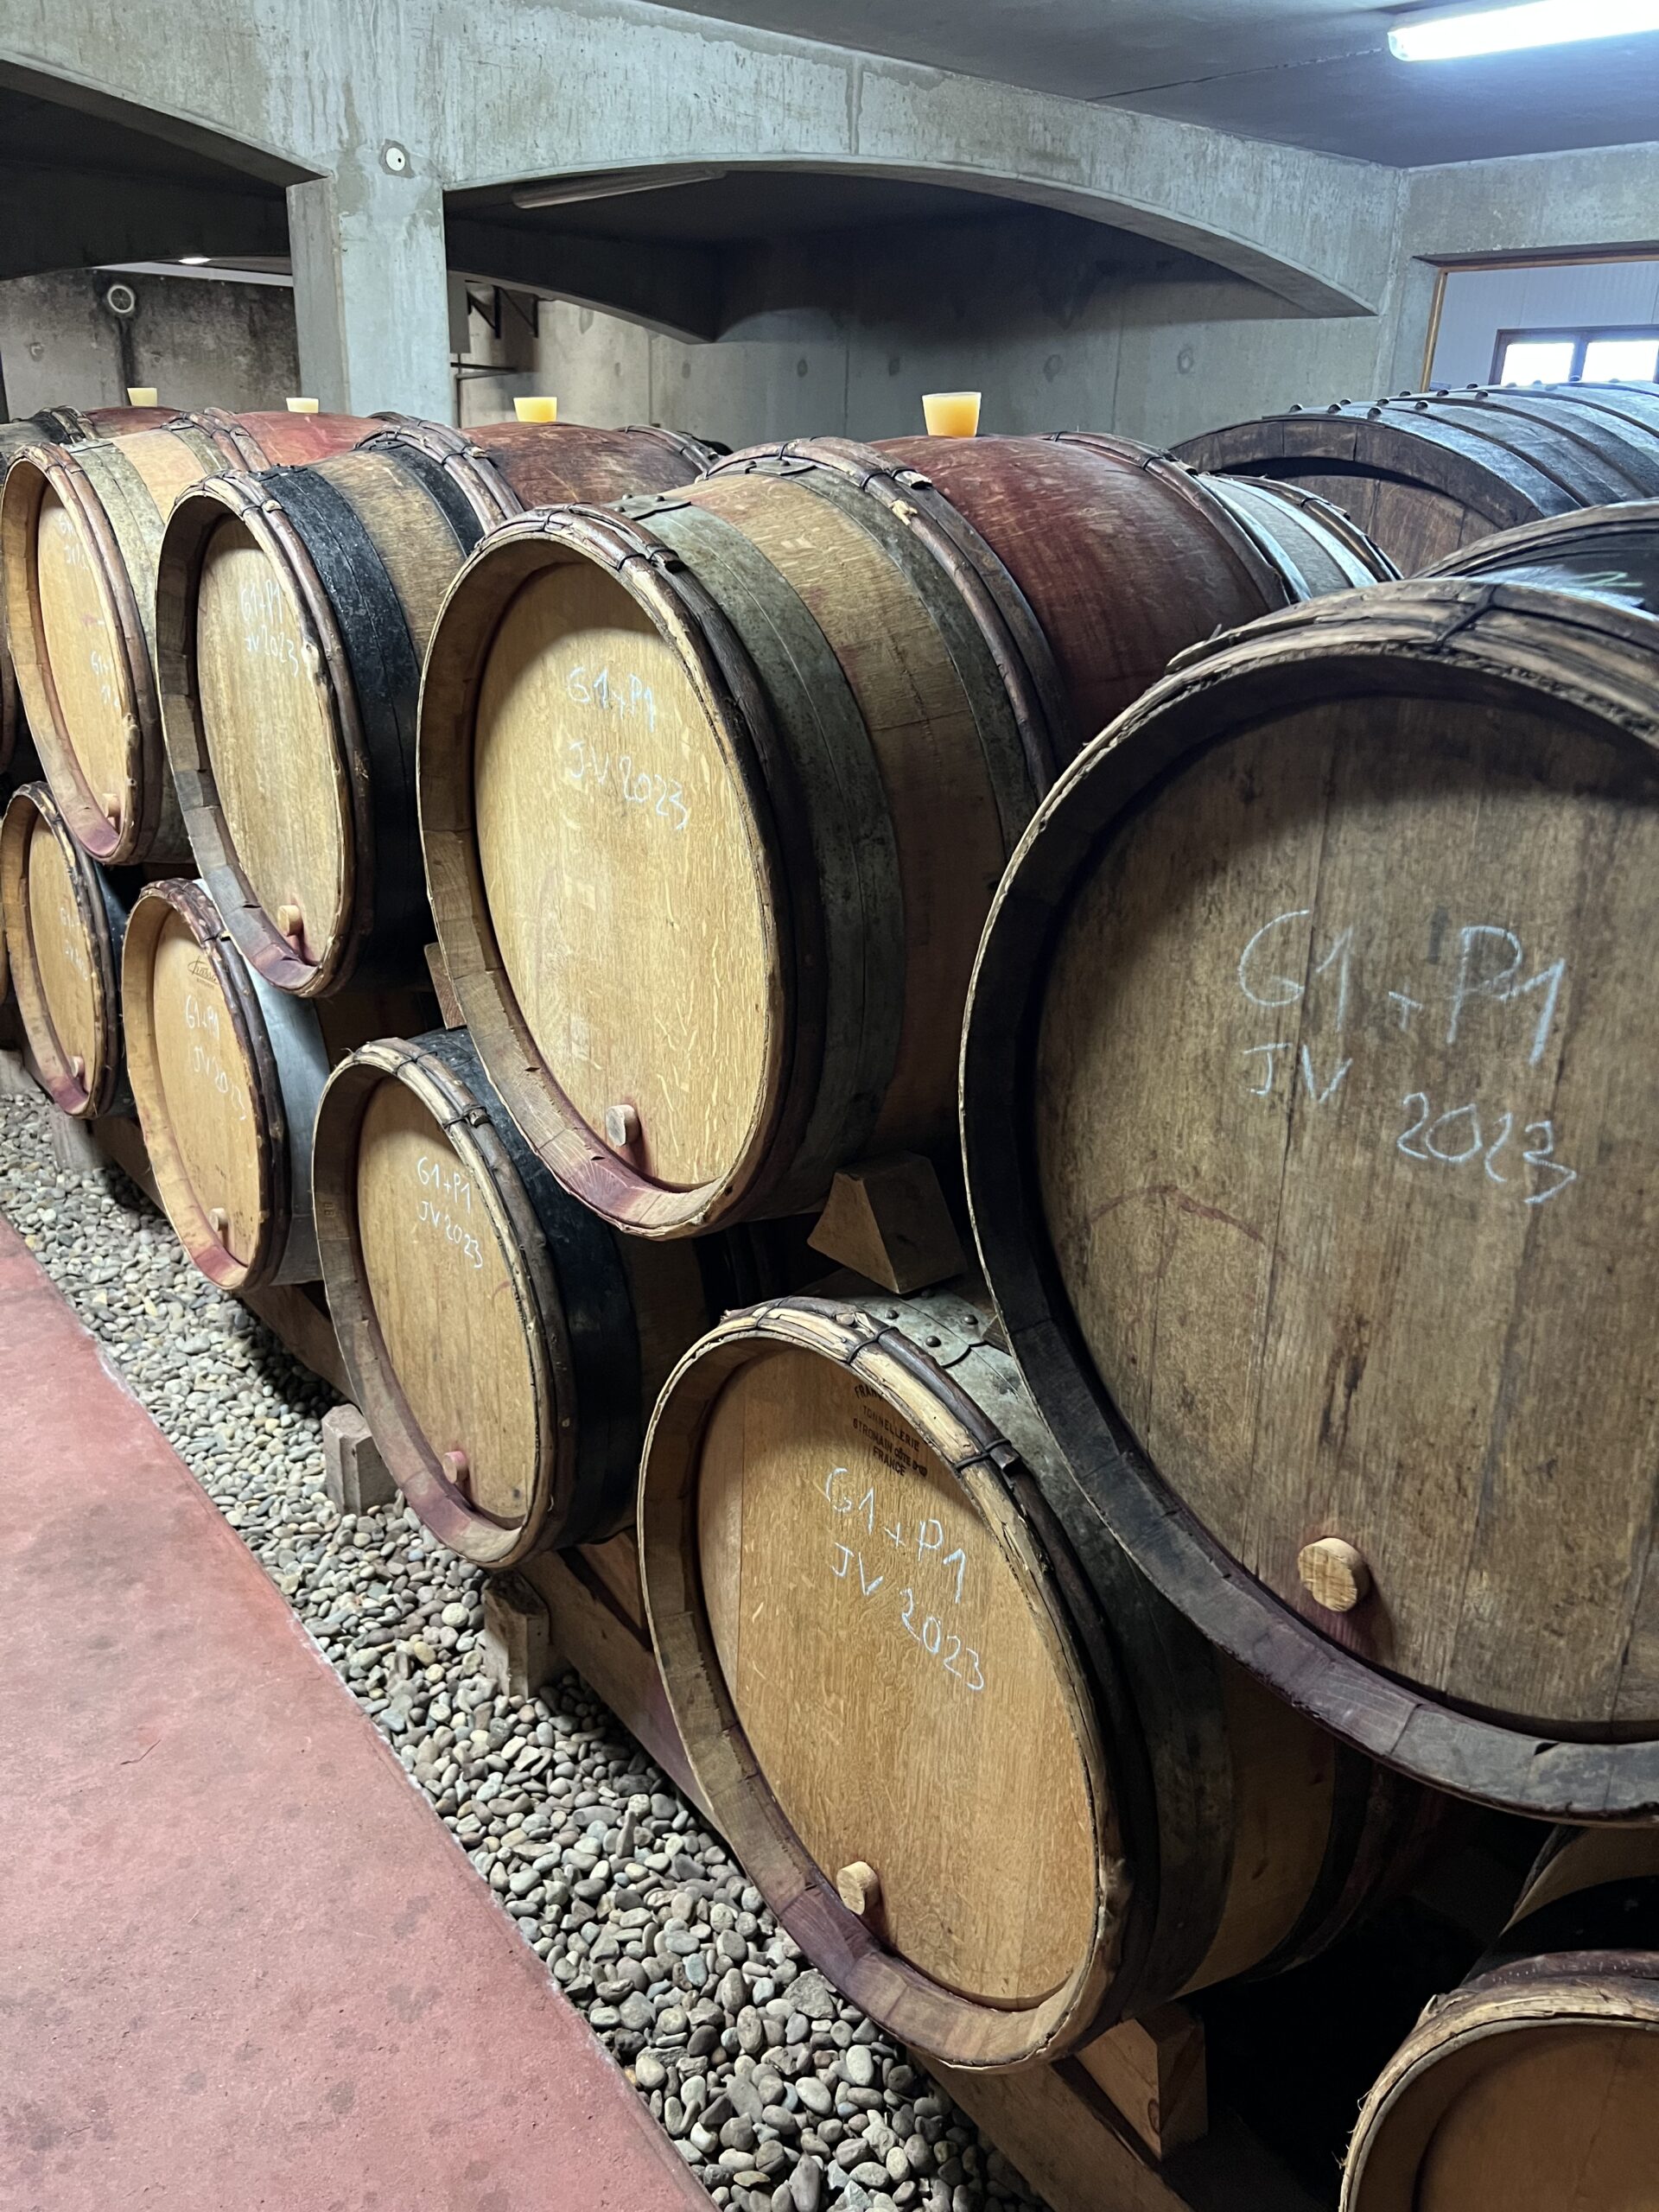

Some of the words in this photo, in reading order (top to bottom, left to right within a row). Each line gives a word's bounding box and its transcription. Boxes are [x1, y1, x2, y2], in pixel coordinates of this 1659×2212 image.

[261, 624, 299, 678] 2023
[619, 755, 691, 831] 2023
[1242, 1041, 1354, 1105] JV
[1395, 1090, 1579, 1205] 2023
[418, 1200, 442, 1228] JV
[444, 1214, 484, 1269] 2023
[863, 1405, 920, 1452] TONNELLERIE
[873, 1445, 906, 1477] FRANCE
[830, 1541, 884, 1596] JV
[898, 1587, 985, 1691] 2023
